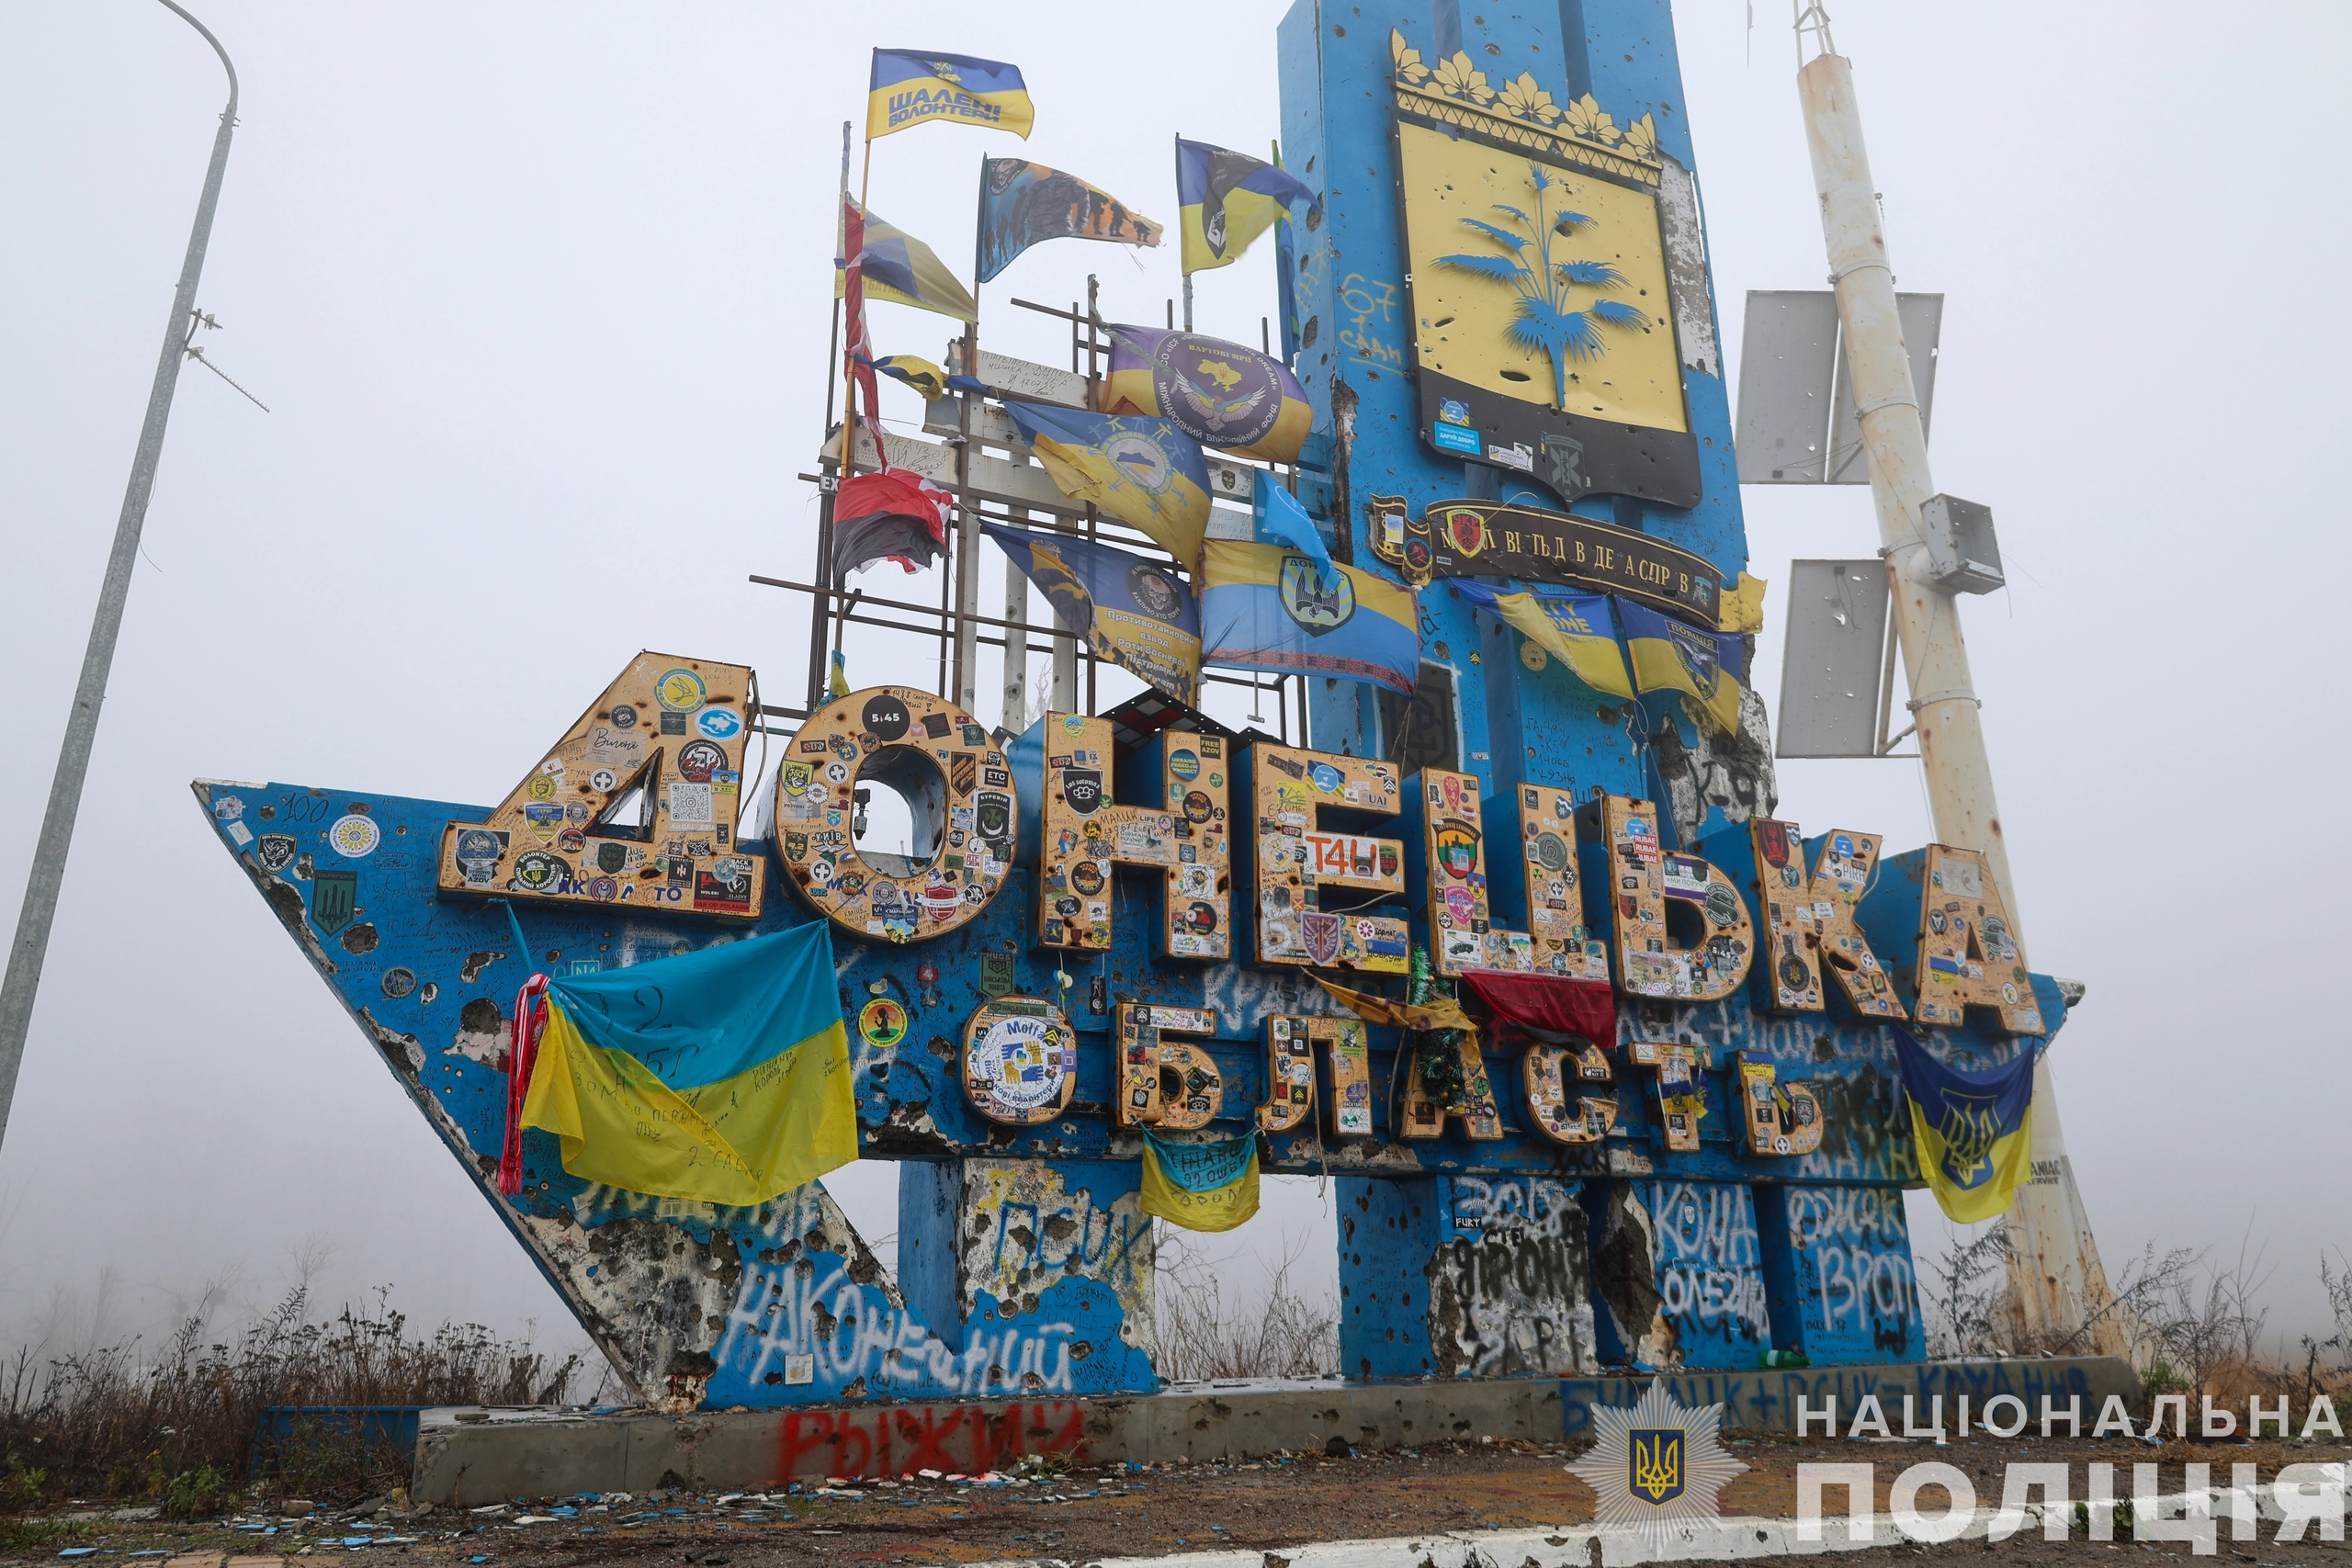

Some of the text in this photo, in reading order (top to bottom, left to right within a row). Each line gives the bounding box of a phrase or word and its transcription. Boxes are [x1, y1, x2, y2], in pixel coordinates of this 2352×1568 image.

[888, 88, 1001, 117] ШАЛЕНІ
[888, 103, 1000, 128] ВОЛОНТЕРИ
[1340, 273, 1396, 322] 67
[1188, 344, 1252, 364] ВАРТОВІ МРІЇ
[1256, 356, 1278, 390] DREAM»
[1158, 381, 1203, 438] МІЖНАРОДНИЙ
[1261, 402, 1279, 429] ФОНД
[1440, 432, 1476, 446] ДАРУЙ ДОБРО
[1453, 514, 1479, 527] УКР
[1107, 610, 1194, 646] Противотанковий
[1139, 632, 1170, 649] взвод
[1670, 623, 1714, 649] ПОЛІЦІЯ
[1117, 637, 1185, 667] Роти Вогневої
[1125, 652, 1177, 677] Підтримки
[1201, 739, 1219, 748] FREE
[988, 771, 1006, 781] ETC
[979, 795, 1008, 804] БУРЕВІЙ
[1368, 793, 1387, 806] UAI
[345, 816, 372, 826] Foundation
[816, 830, 842, 842] КИЇВ
[1634, 834, 1656, 844] RUBAE
[435, 649, 2047, 1039] ДОНЕЦЬКА
[1635, 843, 1657, 854] RUBAE
[519, 852, 551, 863] ВОЛОНТЕР
[1305, 835, 1377, 874] T4U
[318, 872, 356, 880] DEFENDER
[515, 867, 535, 888] СИЛЬНИЙ
[719, 903, 750, 911] POLAKÓW
[986, 952, 1011, 961] HUGS
[983, 975, 1011, 984] ВІЙСЬКОВА
[988, 984, 1006, 992] ПОШТА
[1638, 984, 1672, 993] MAGIC
[961, 994, 1826, 1159] ОБЛАСТЬ
[2030, 1159, 2061, 1176] ANIAC
[1454, 1217, 1481, 1228] FURY
